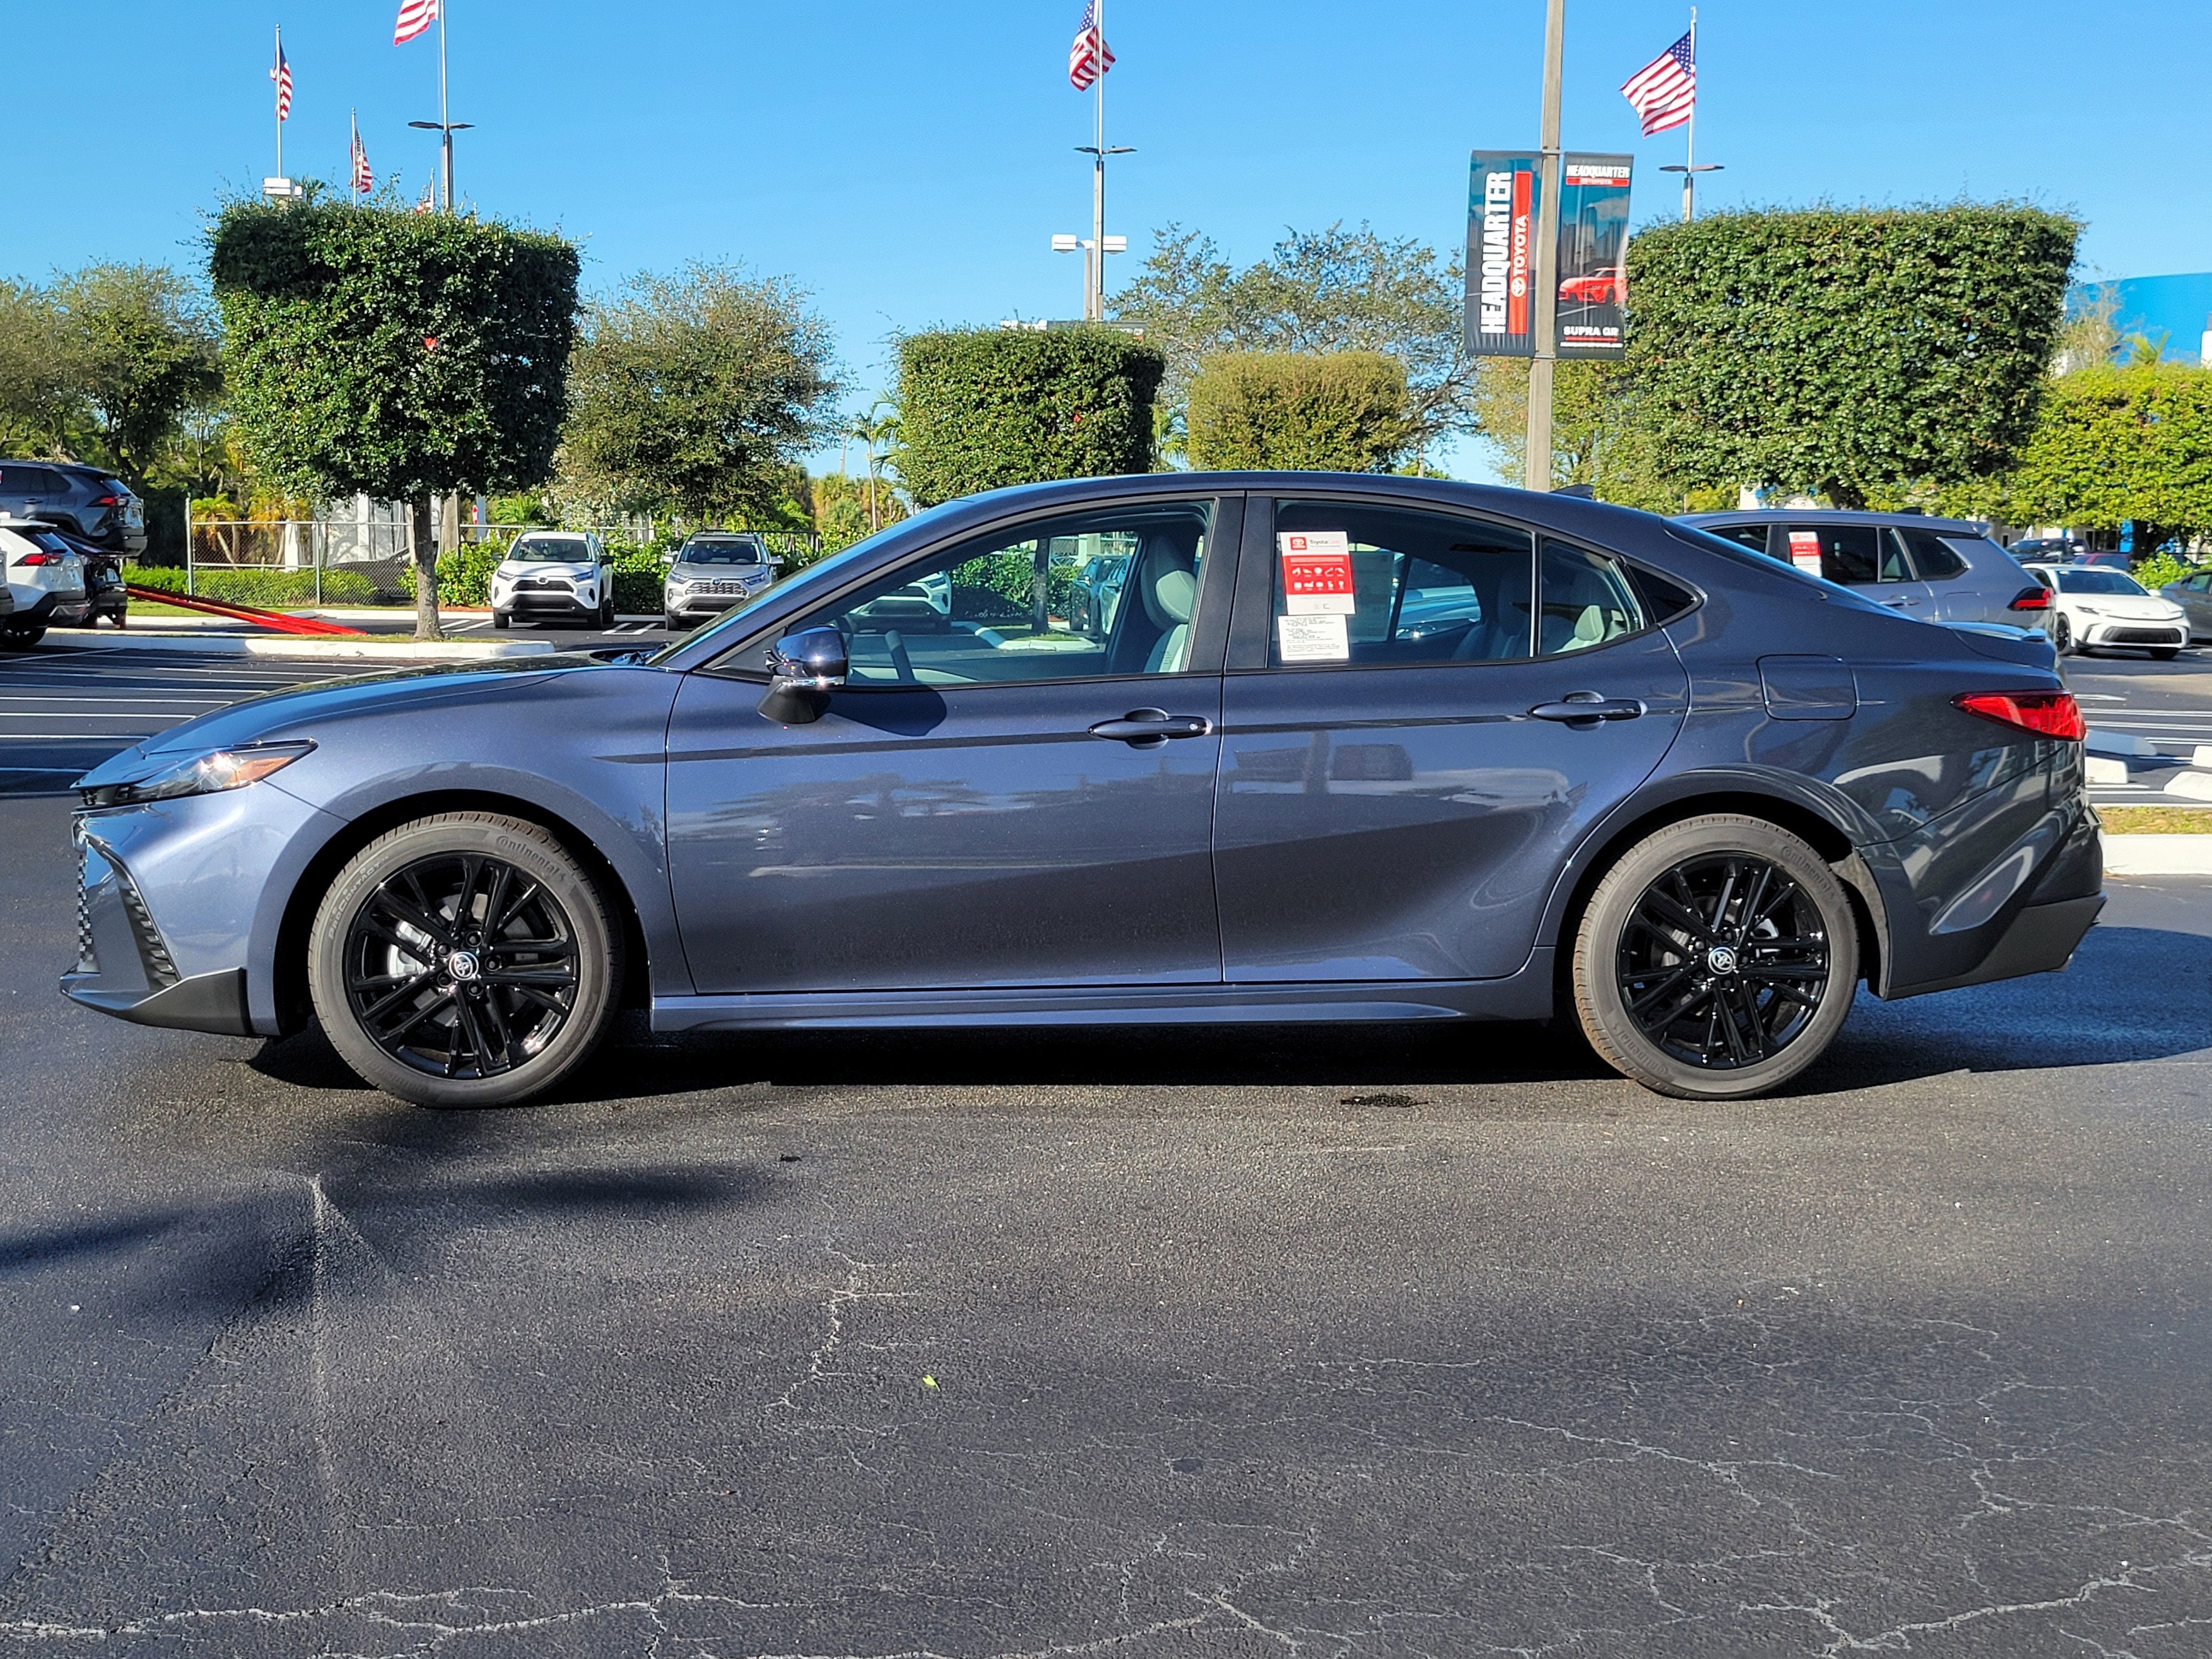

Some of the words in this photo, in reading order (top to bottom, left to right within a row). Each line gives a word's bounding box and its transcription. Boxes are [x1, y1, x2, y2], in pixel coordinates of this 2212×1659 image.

[1566, 165, 1630, 178] HEADQUARTER
[1480, 172, 1512, 334] HEADQUARTER
[1513, 214, 1527, 277] TOYOTA
[1563, 326, 1601, 336] SUPRA
[1602, 326, 1620, 336] GR
[496, 836, 560, 876] Continental
